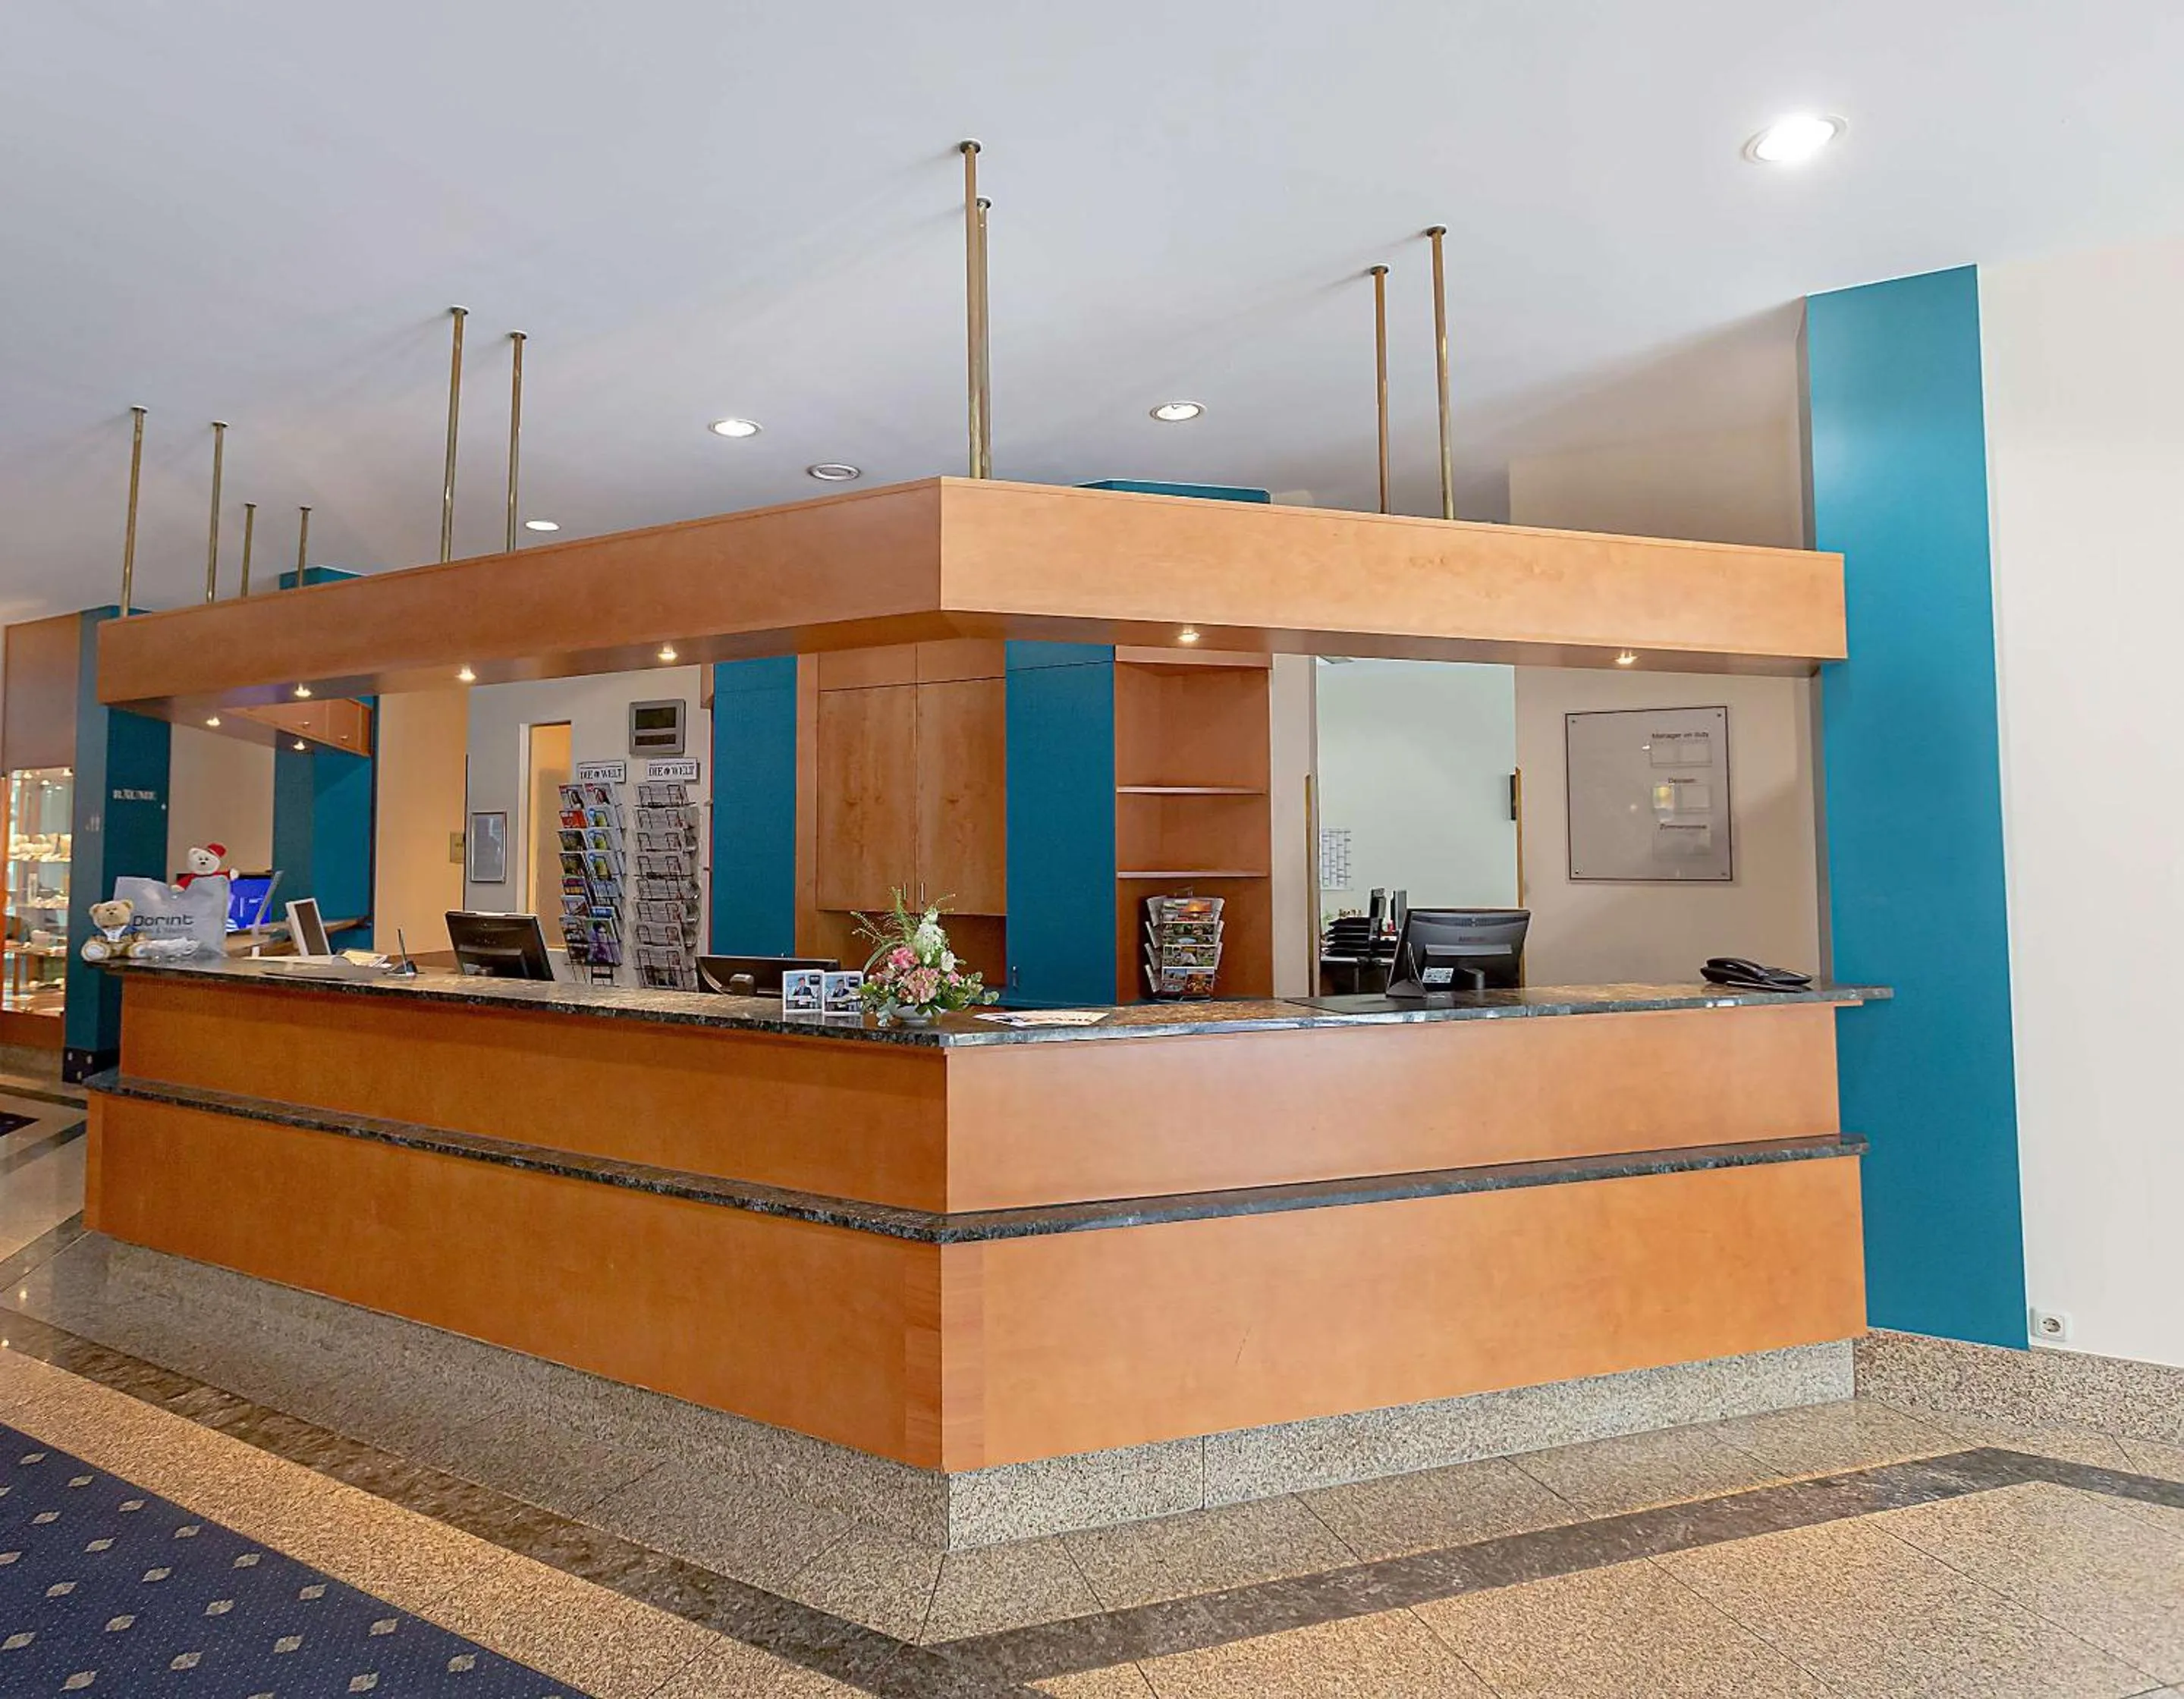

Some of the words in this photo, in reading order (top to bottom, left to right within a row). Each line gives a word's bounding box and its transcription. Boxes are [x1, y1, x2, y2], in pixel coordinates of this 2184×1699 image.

[580, 770, 593, 779] DIE
[601, 768, 622, 778] WELT
[649, 766, 663, 777] DIE
[134, 914, 194, 926] Dorint
